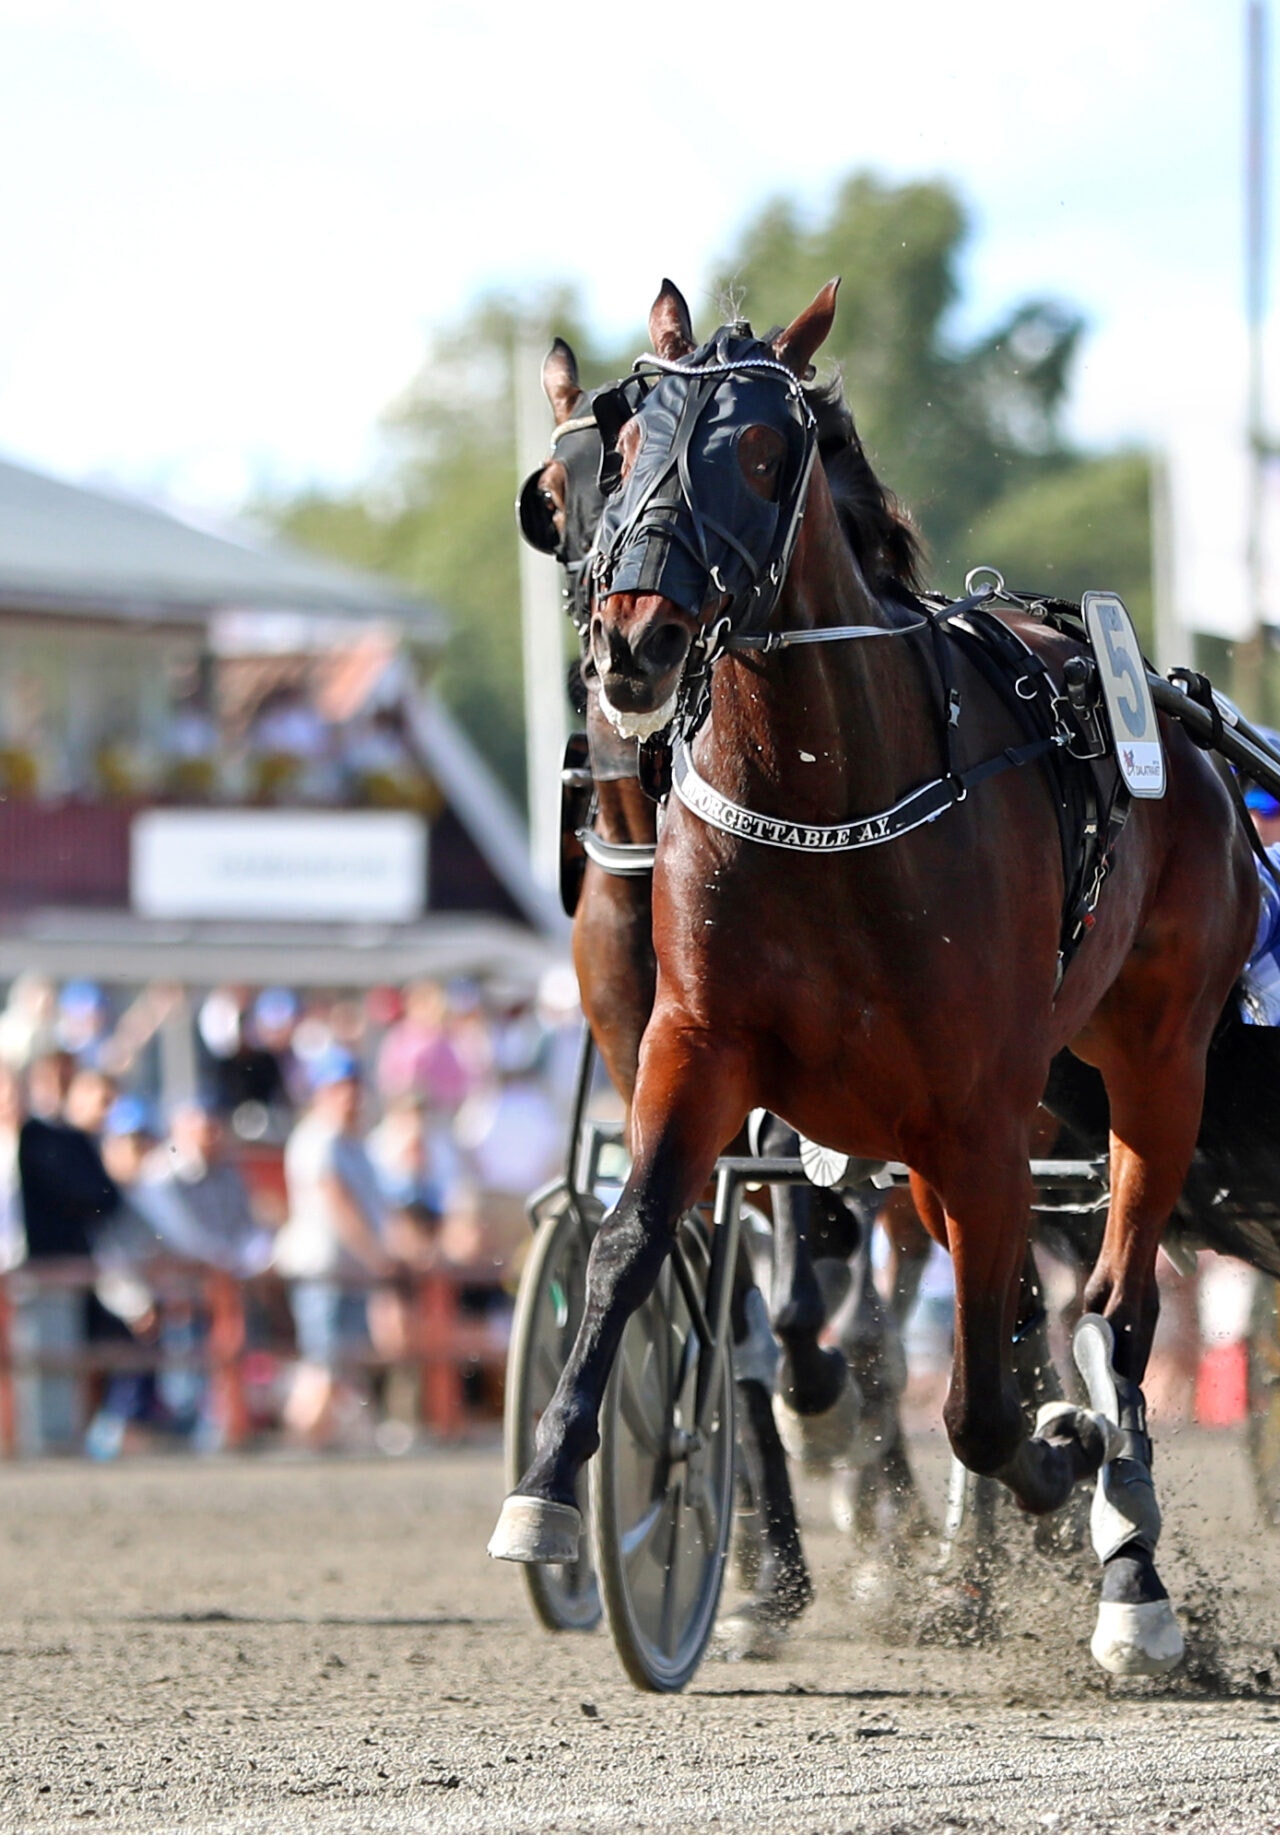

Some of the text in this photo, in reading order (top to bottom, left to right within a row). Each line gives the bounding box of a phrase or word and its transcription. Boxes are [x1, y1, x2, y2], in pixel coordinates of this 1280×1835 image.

[1096, 605, 1146, 738] 5
[681, 774, 890, 847] FORGETTABLE A.Y.
